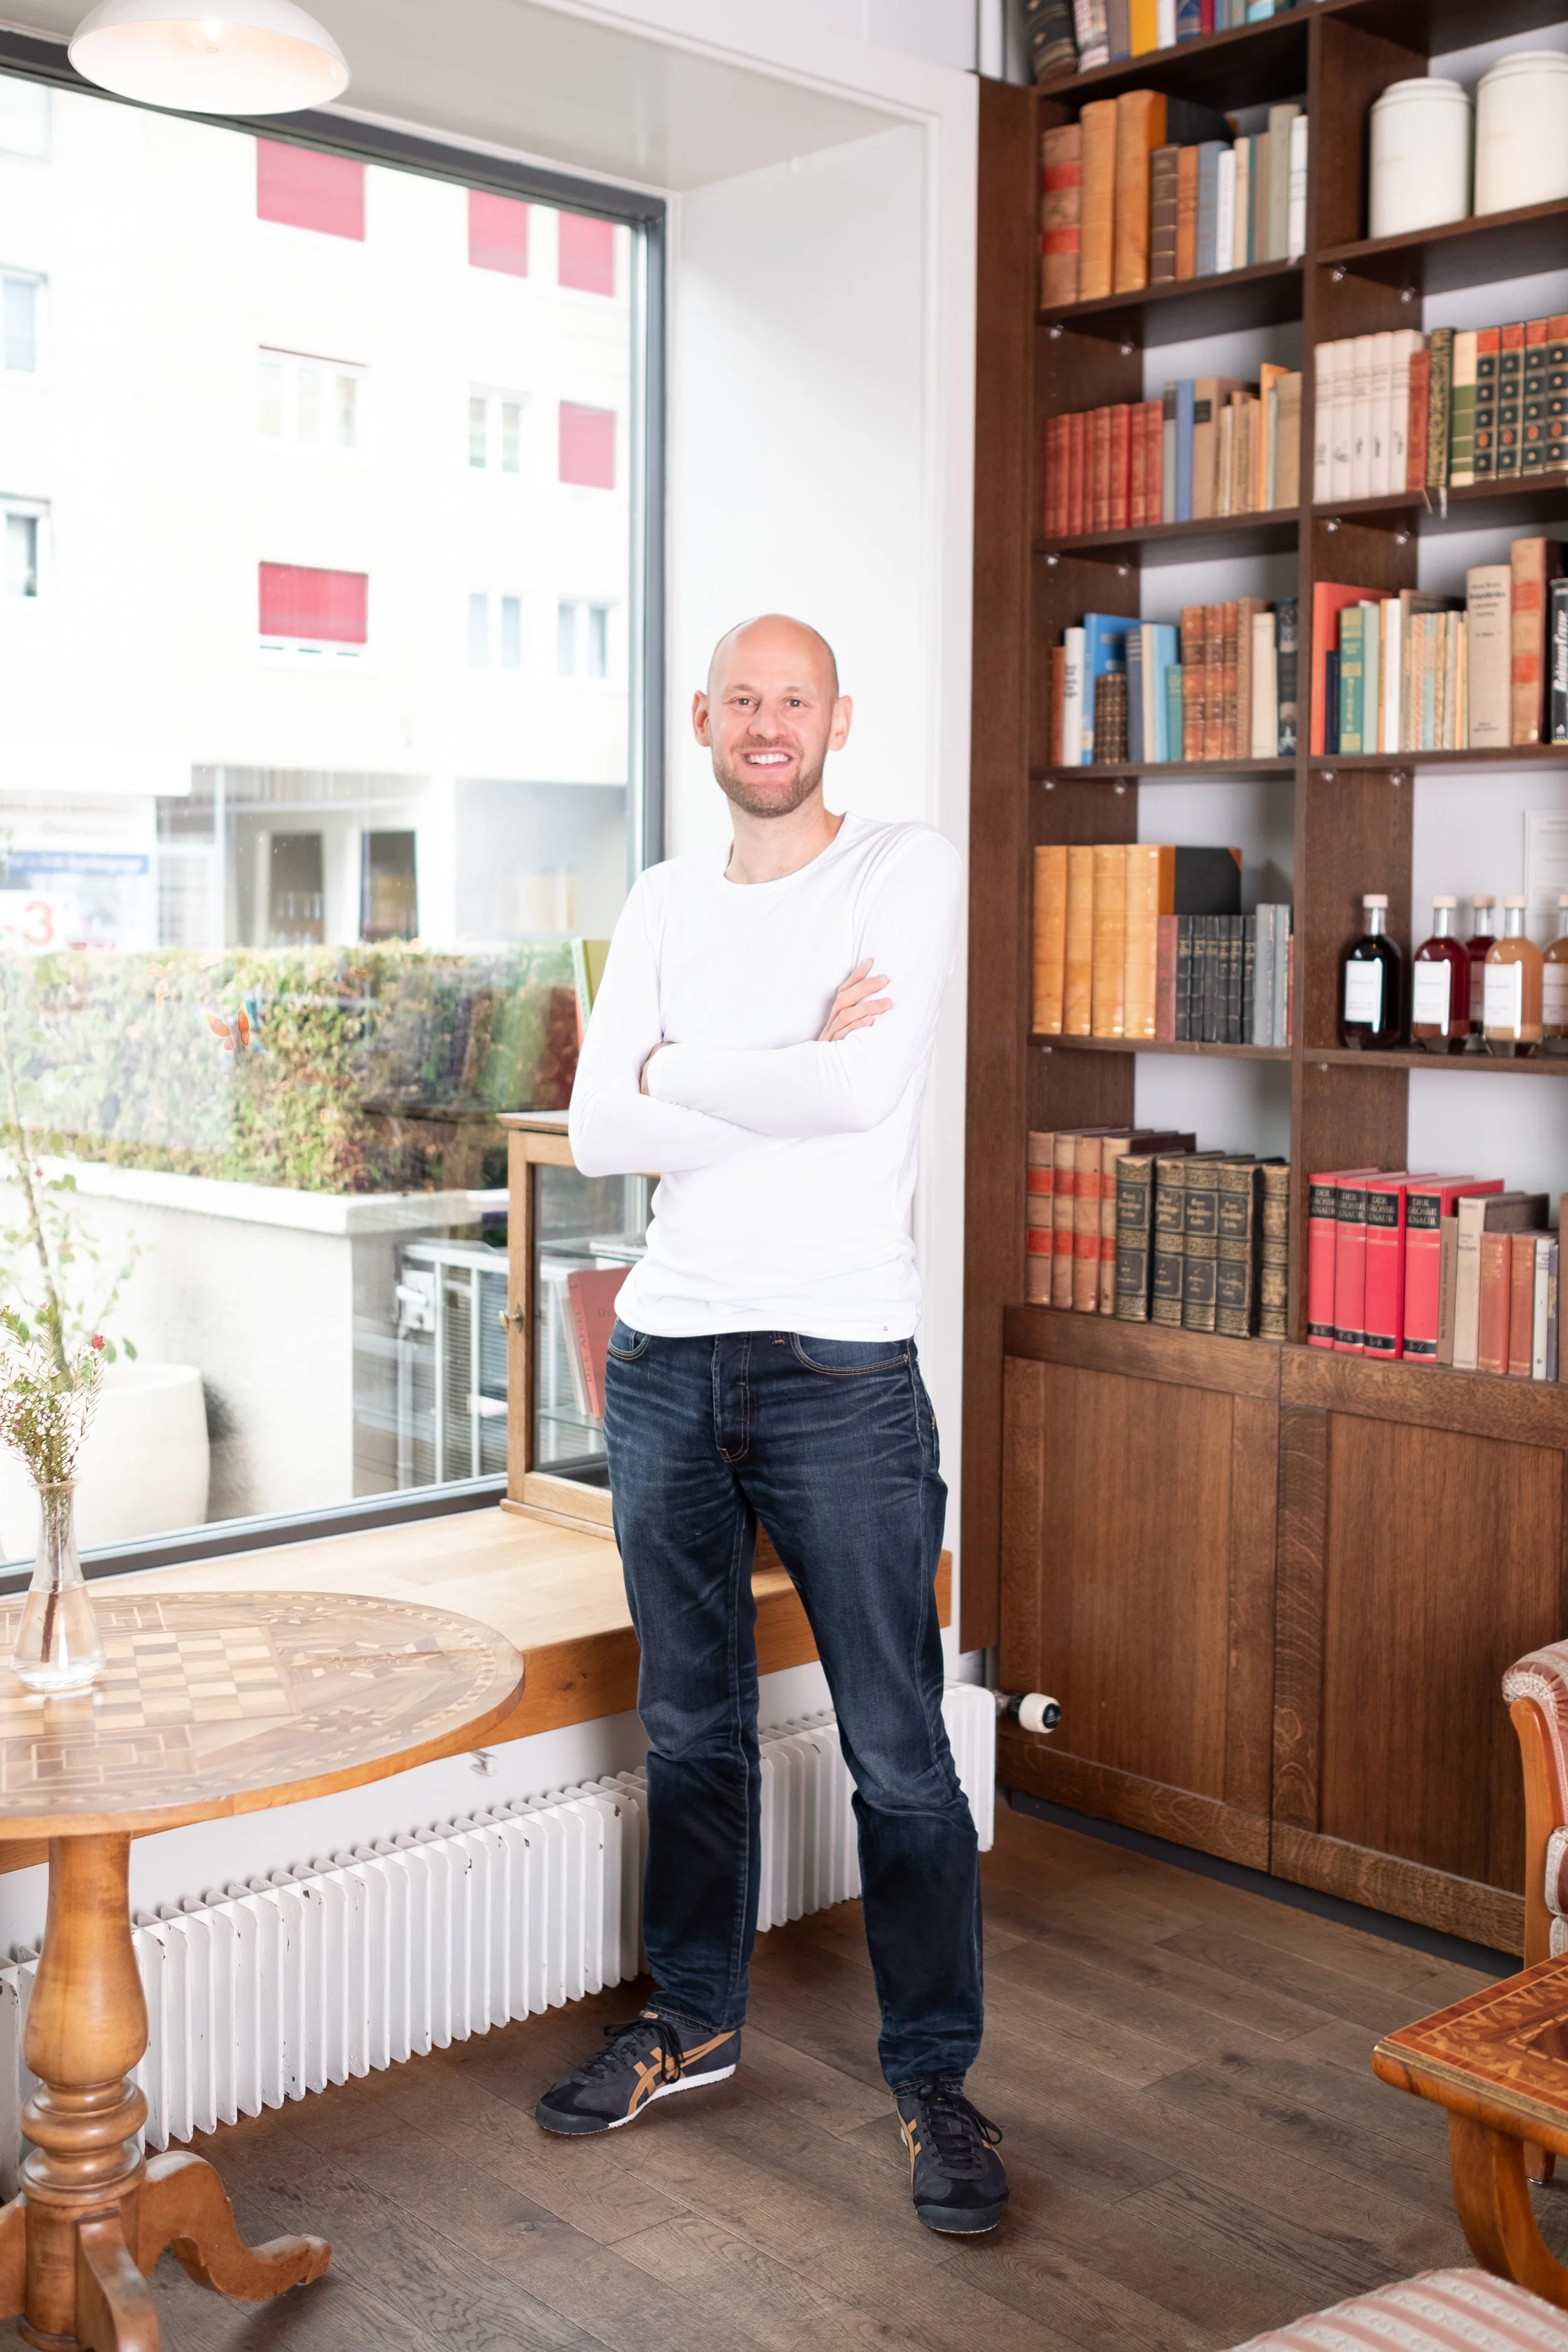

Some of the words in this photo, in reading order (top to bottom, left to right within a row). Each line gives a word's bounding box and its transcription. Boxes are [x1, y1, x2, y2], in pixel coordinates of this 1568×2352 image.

[1315, 1189, 1330, 1197] DER
[1342, 1192, 1357, 1200] DER
[1372, 1195, 1387, 1204] DER
[1412, 1198, 1429, 1207] DER
[1408, 1205, 1437, 1216] GROSSE
[1408, 1215, 1436, 1225] KNAUR
[598, 1308, 614, 1317] DE
